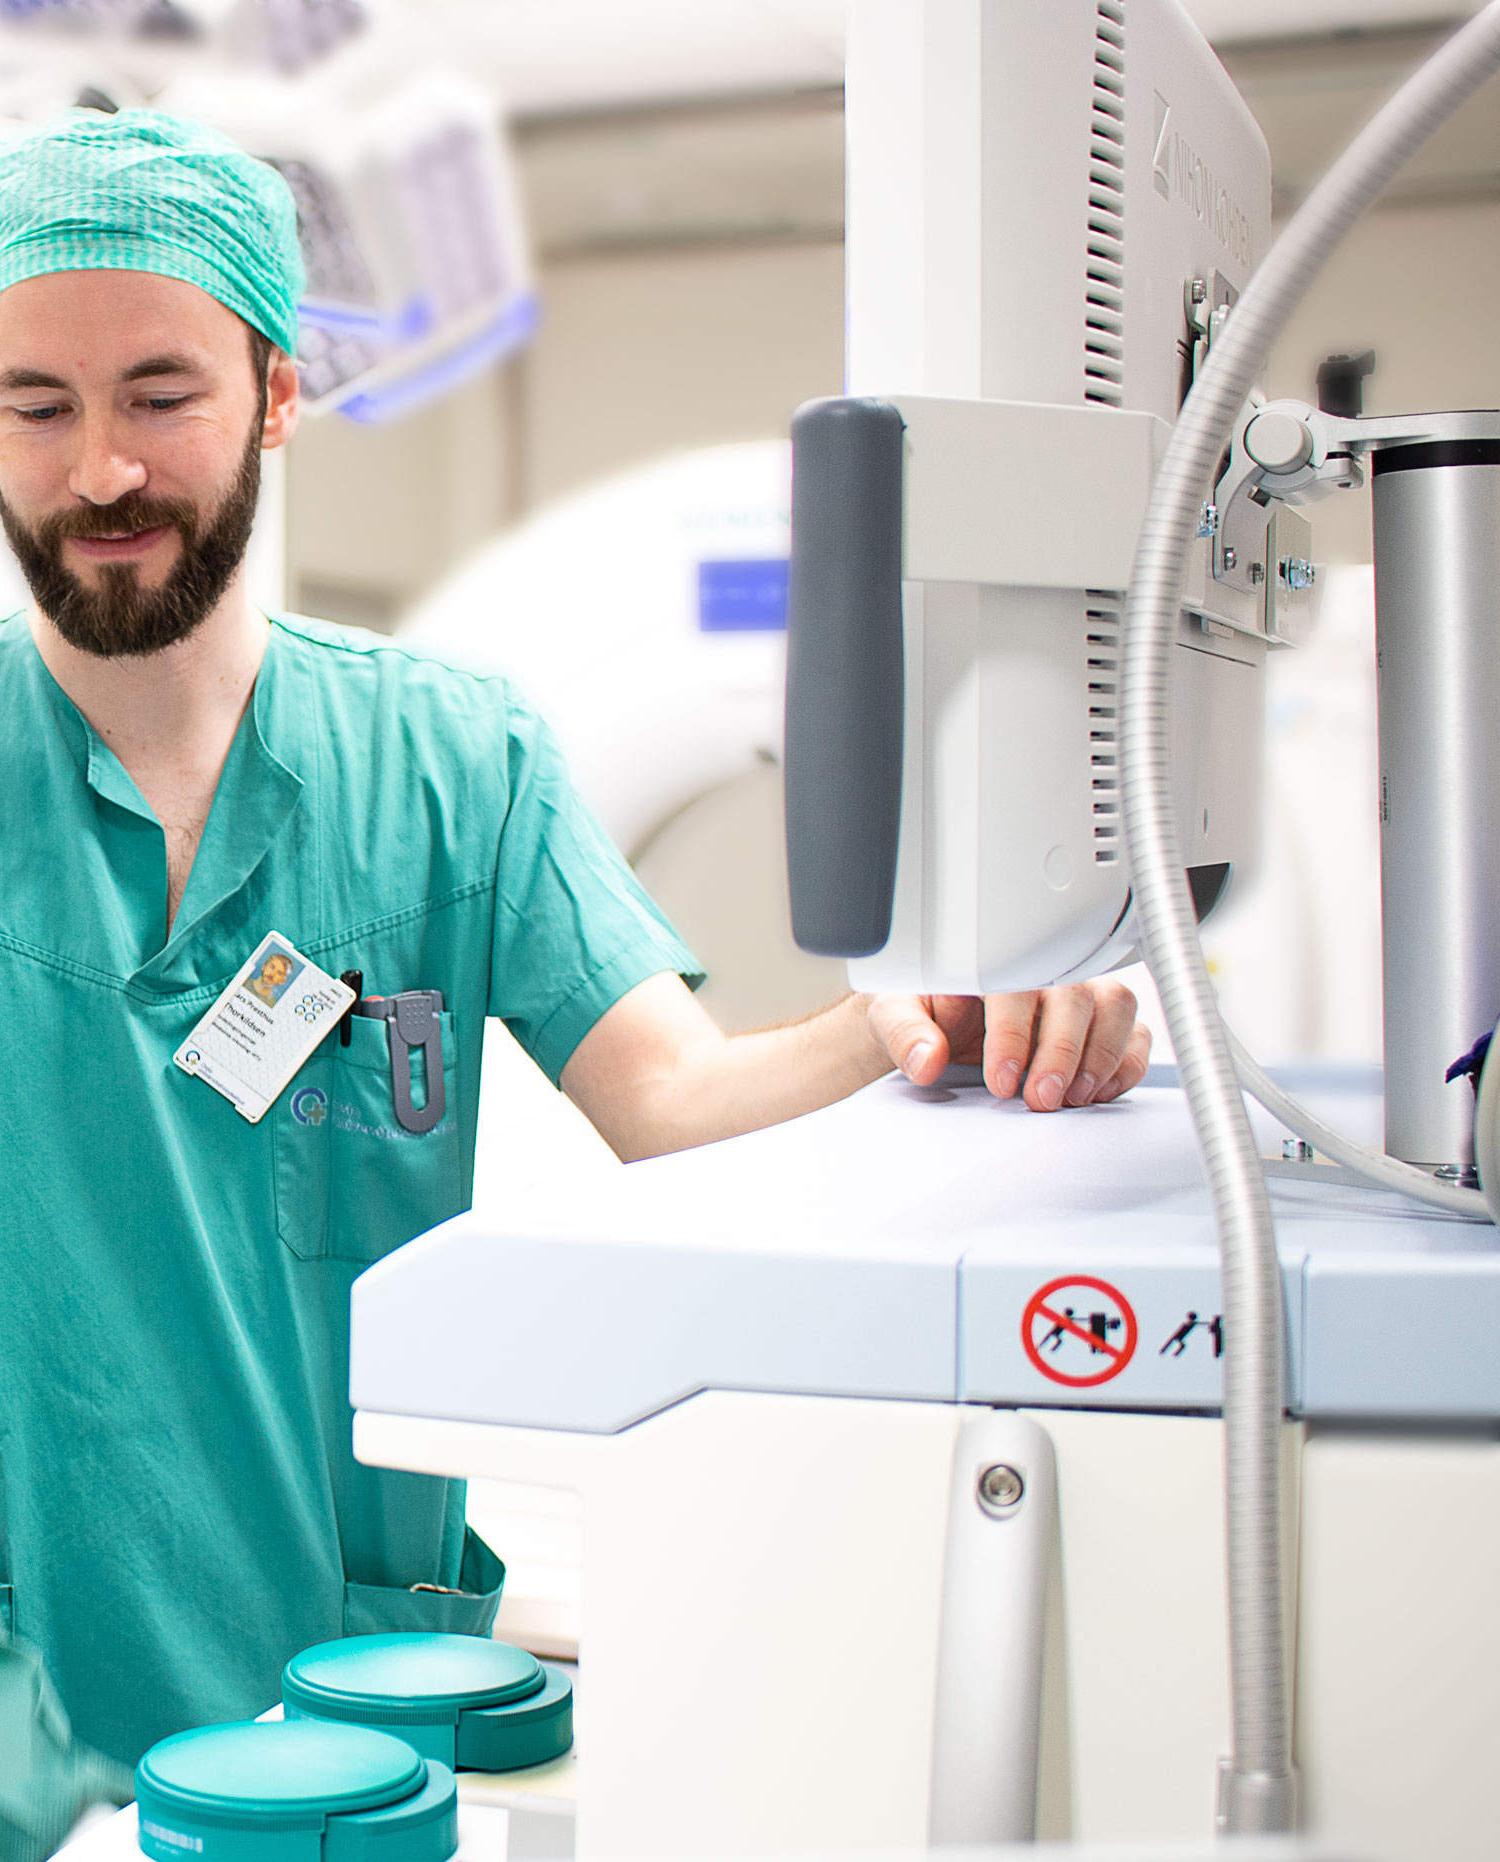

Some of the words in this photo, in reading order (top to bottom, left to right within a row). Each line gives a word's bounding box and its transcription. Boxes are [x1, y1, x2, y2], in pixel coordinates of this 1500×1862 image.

[223, 1001, 268, 1038] Thorkildsen
[233, 991, 247, 1003] ars
[245, 999, 275, 1025] Presthus
